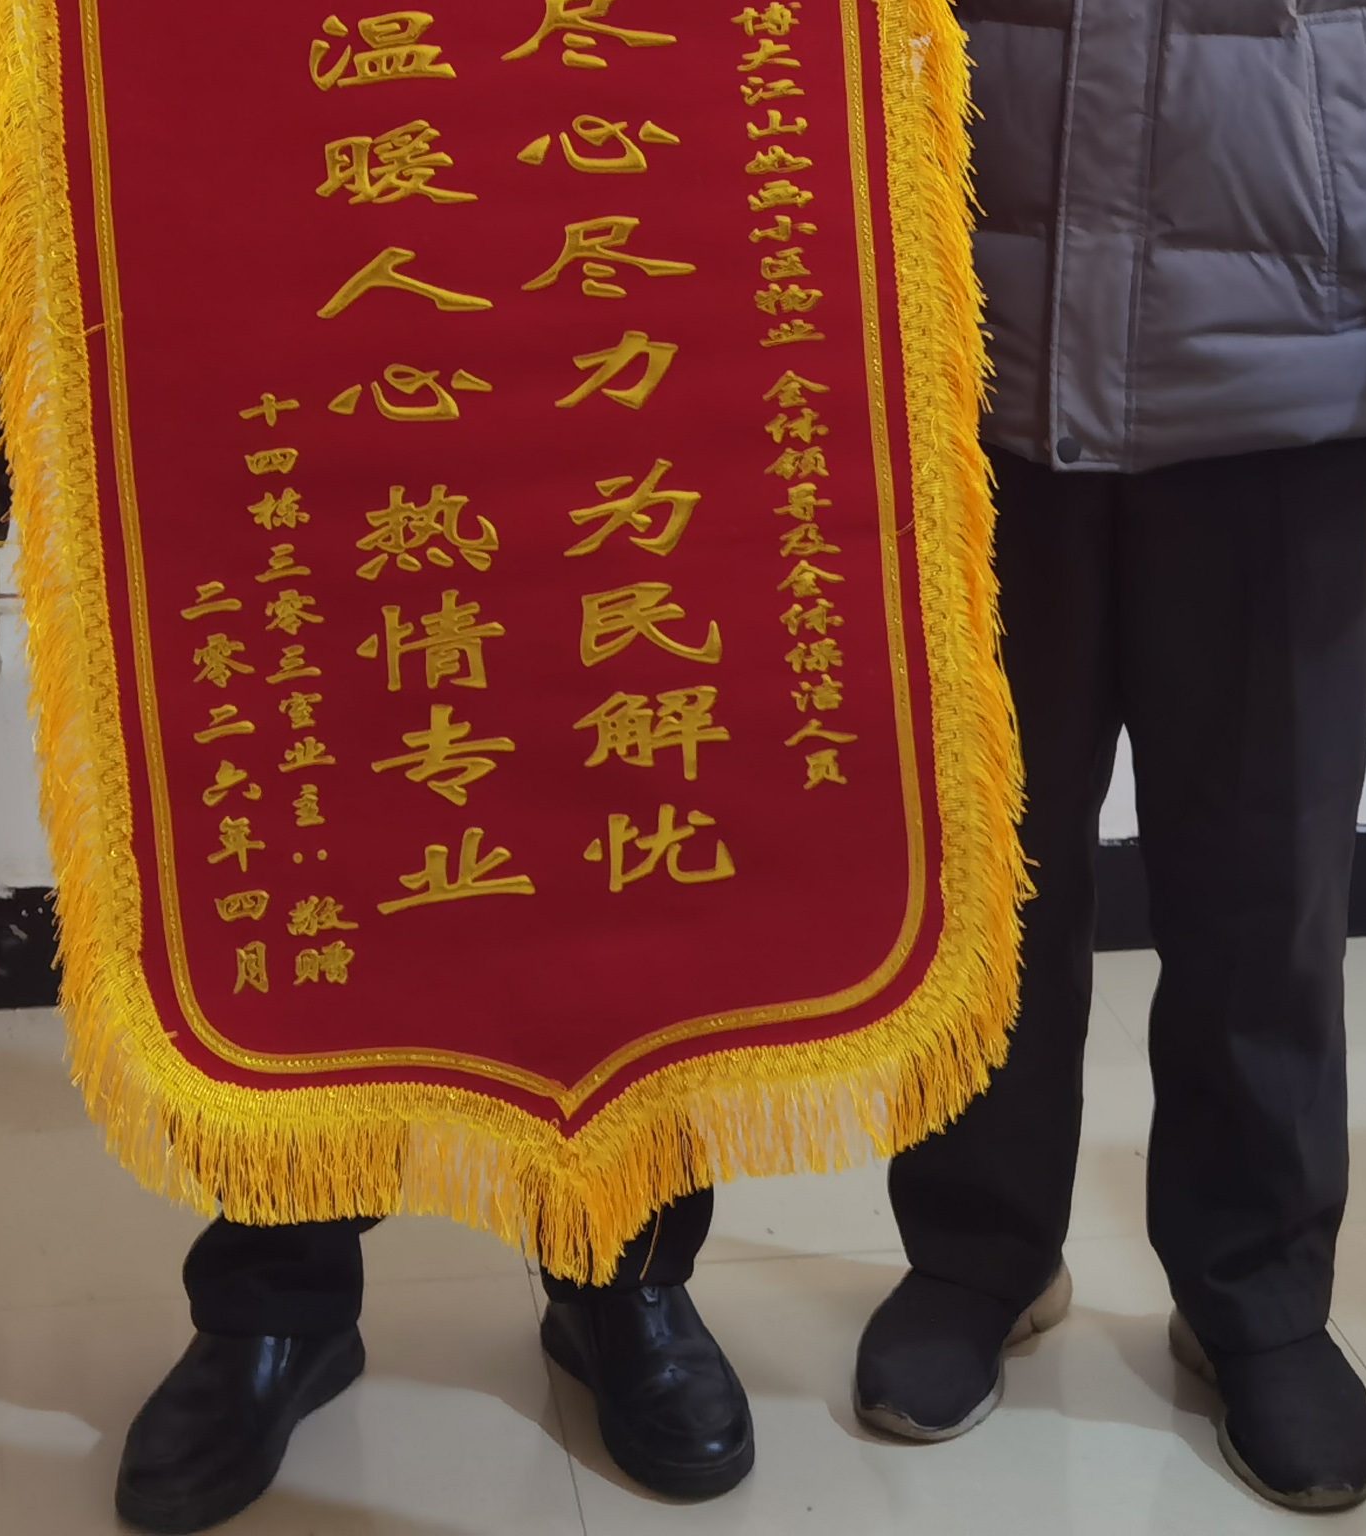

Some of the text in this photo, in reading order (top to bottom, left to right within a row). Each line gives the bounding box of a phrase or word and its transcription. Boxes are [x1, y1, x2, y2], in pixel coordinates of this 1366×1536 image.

[180, 580, 271, 994] 二零二六年四月
[309, 10, 536, 916] 温暖人心热情专业
